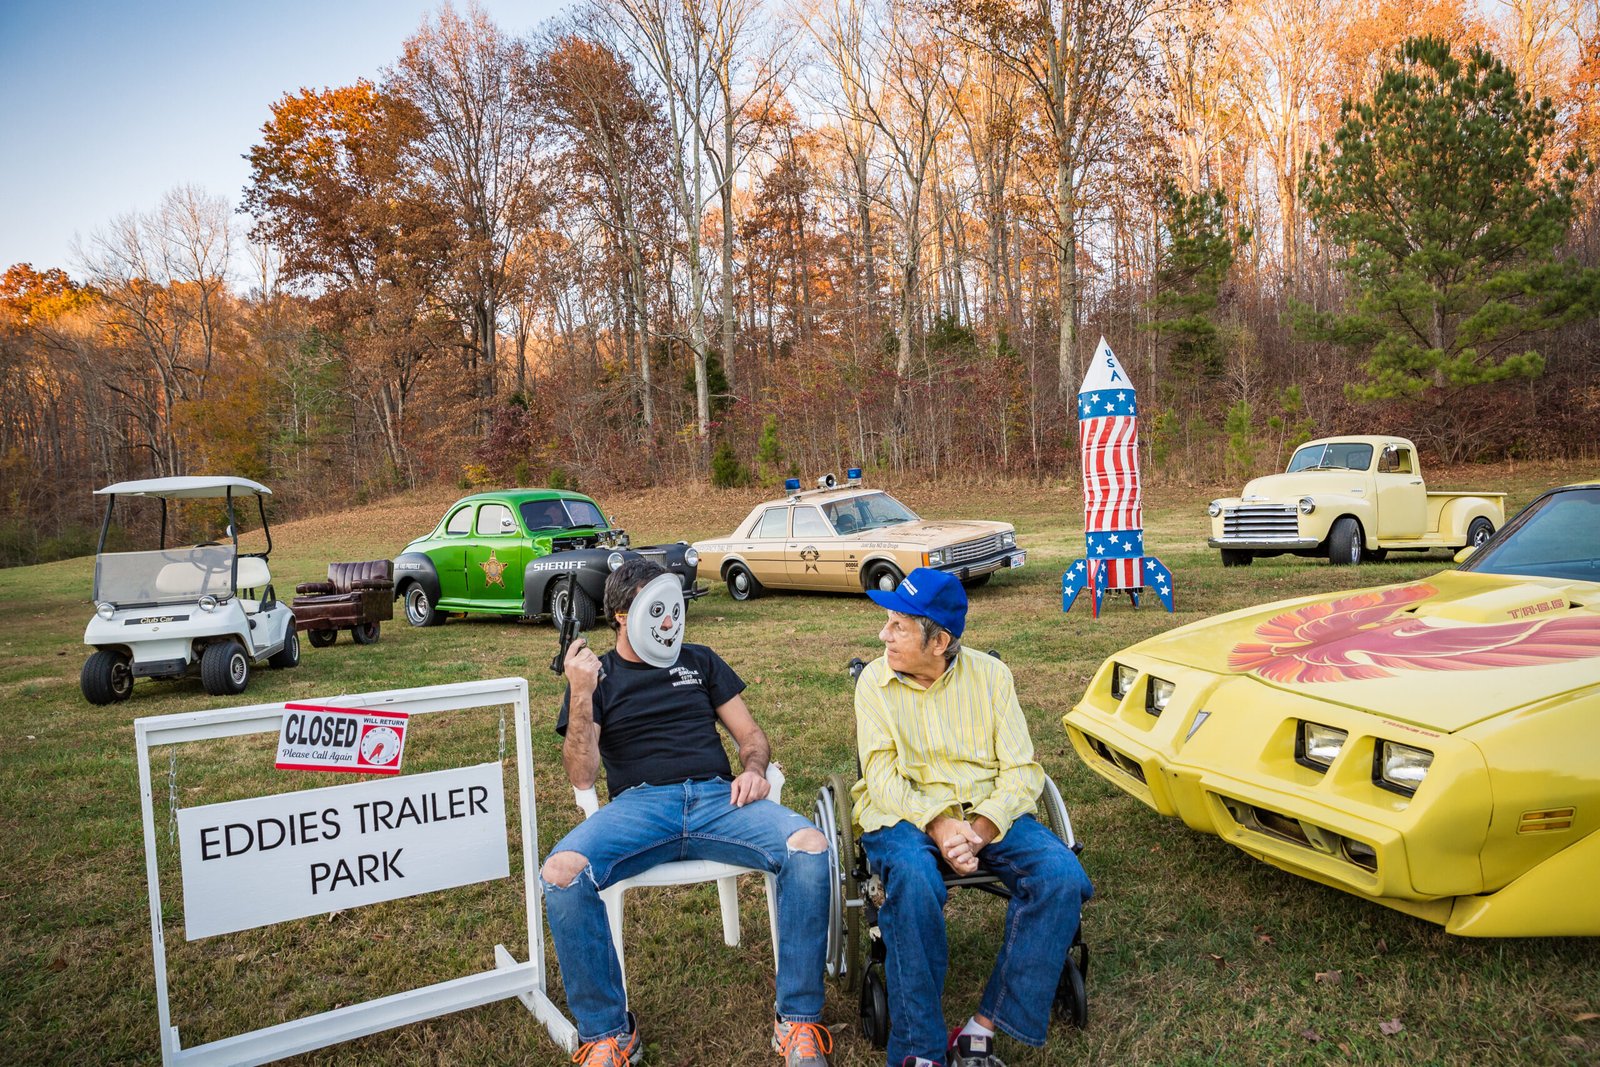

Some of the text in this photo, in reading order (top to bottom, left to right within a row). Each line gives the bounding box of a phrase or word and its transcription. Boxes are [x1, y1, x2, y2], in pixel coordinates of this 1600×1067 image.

[1104, 349, 1123, 382] USA
[533, 560, 587, 572] SHERIFF
[140, 616, 174, 625] Club Car
[285, 713, 358, 748] CLOSED
[363, 717, 405, 727] WILL RETURN
[282, 748, 353, 764] Please Call Again
[200, 785, 489, 862] EDDIES TRAILER
[310, 848, 405, 895] PARK
